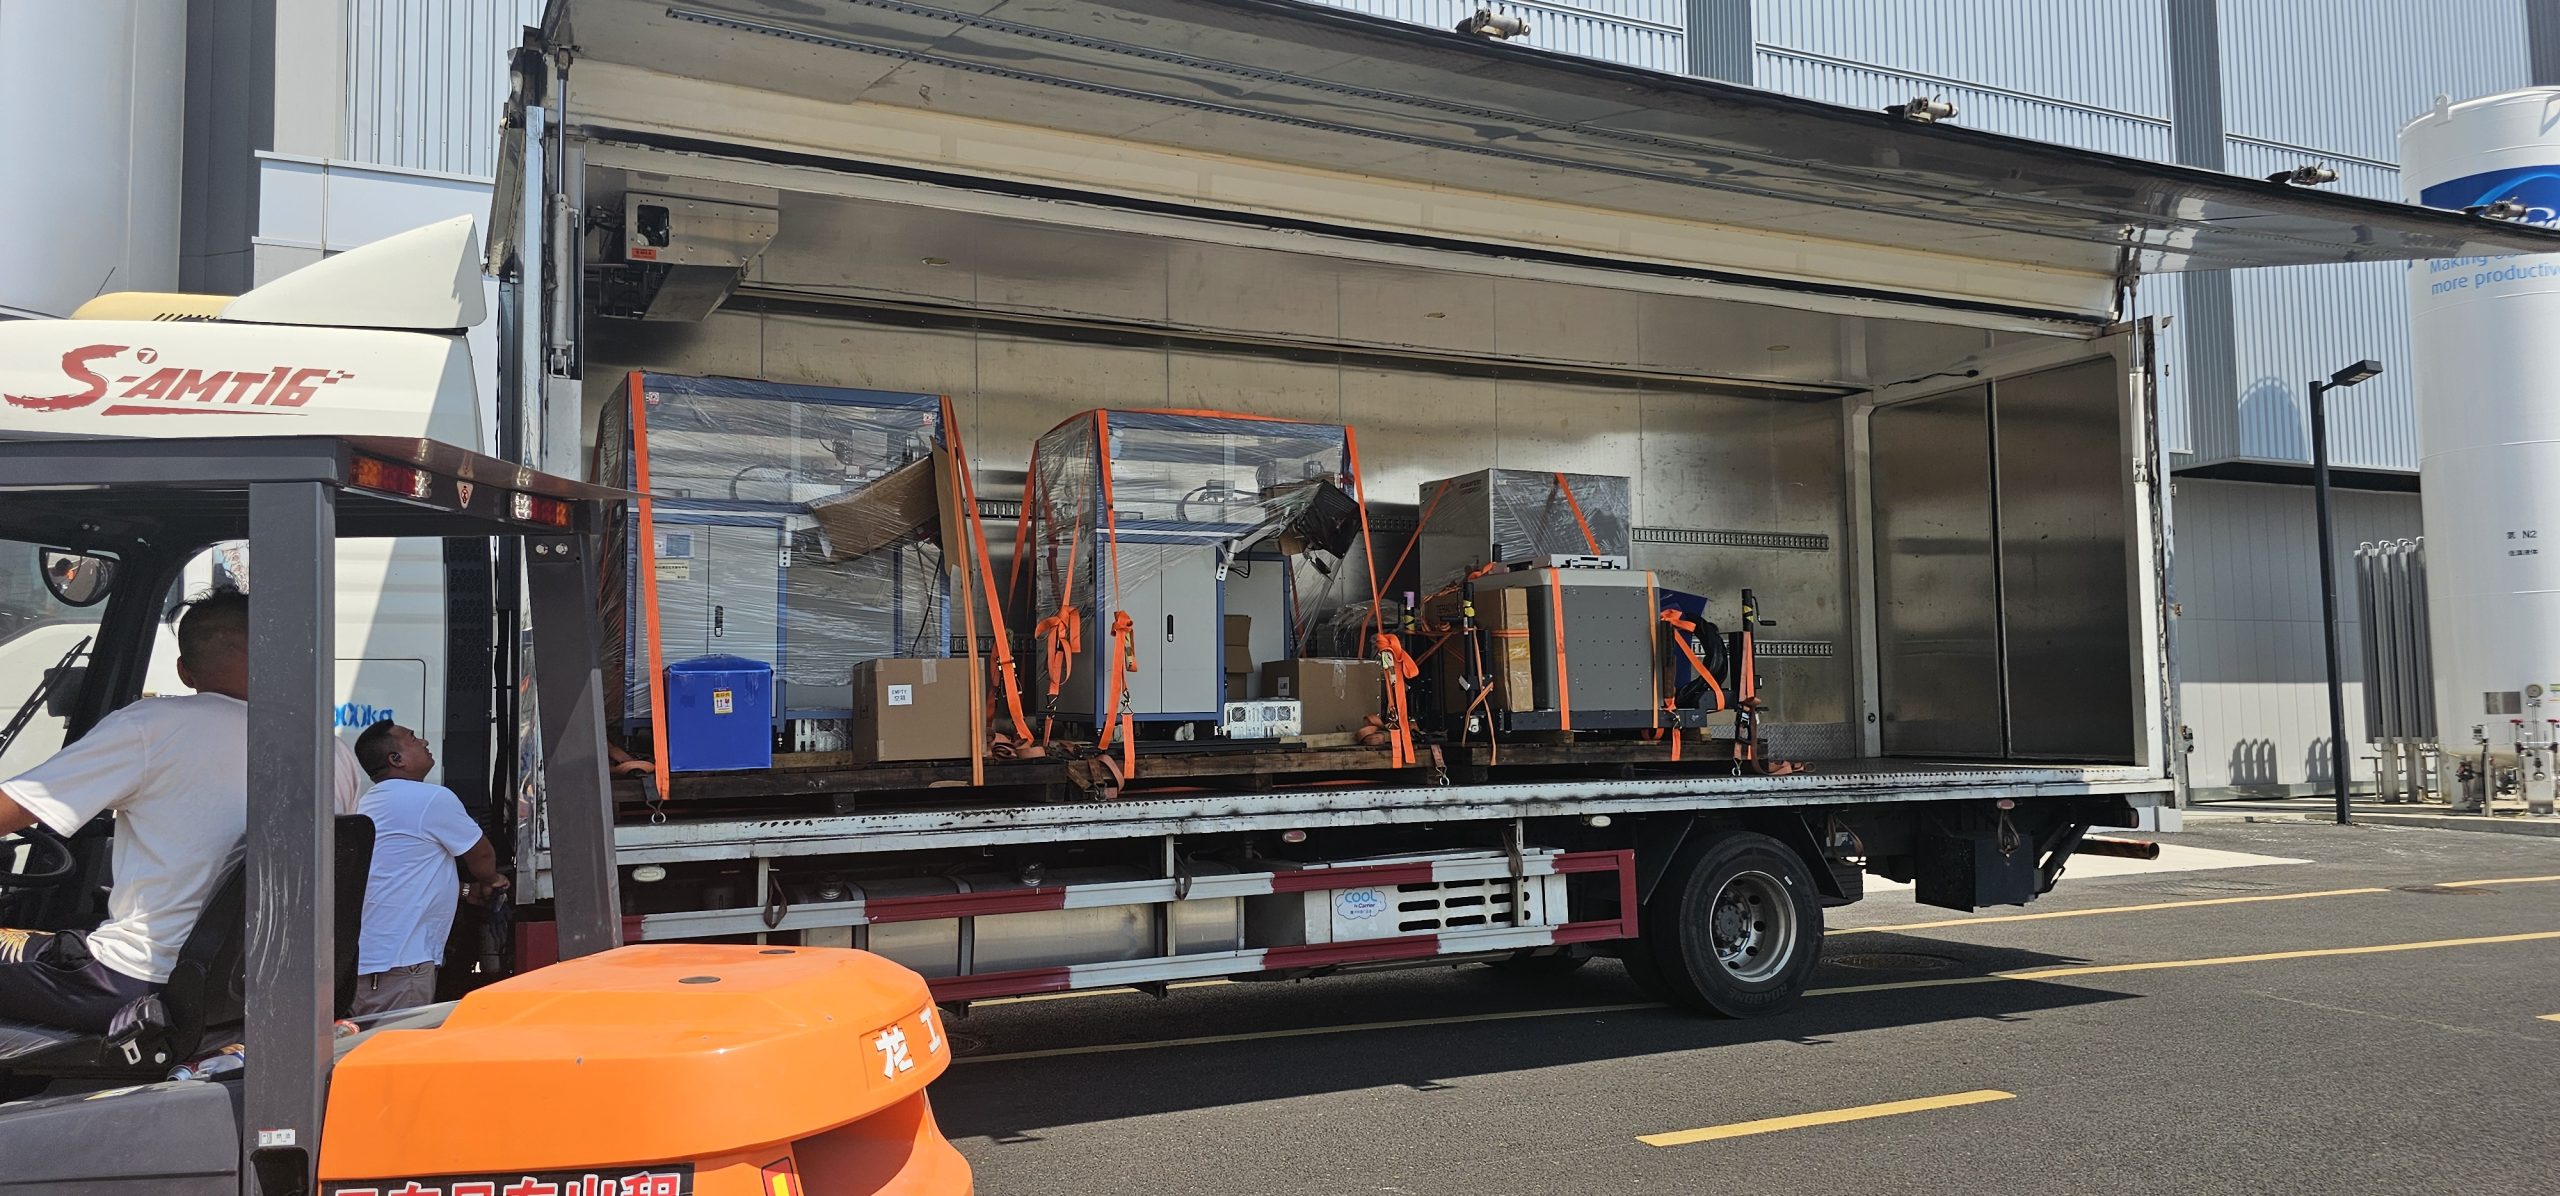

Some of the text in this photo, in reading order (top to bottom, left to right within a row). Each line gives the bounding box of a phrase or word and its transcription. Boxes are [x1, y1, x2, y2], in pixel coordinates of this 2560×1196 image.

[2430, 255, 2488, 274] Making
[2431, 276, 2468, 295] more
[2522, 530, 2537, 539] N2
[1345, 889, 1378, 903] COOL
